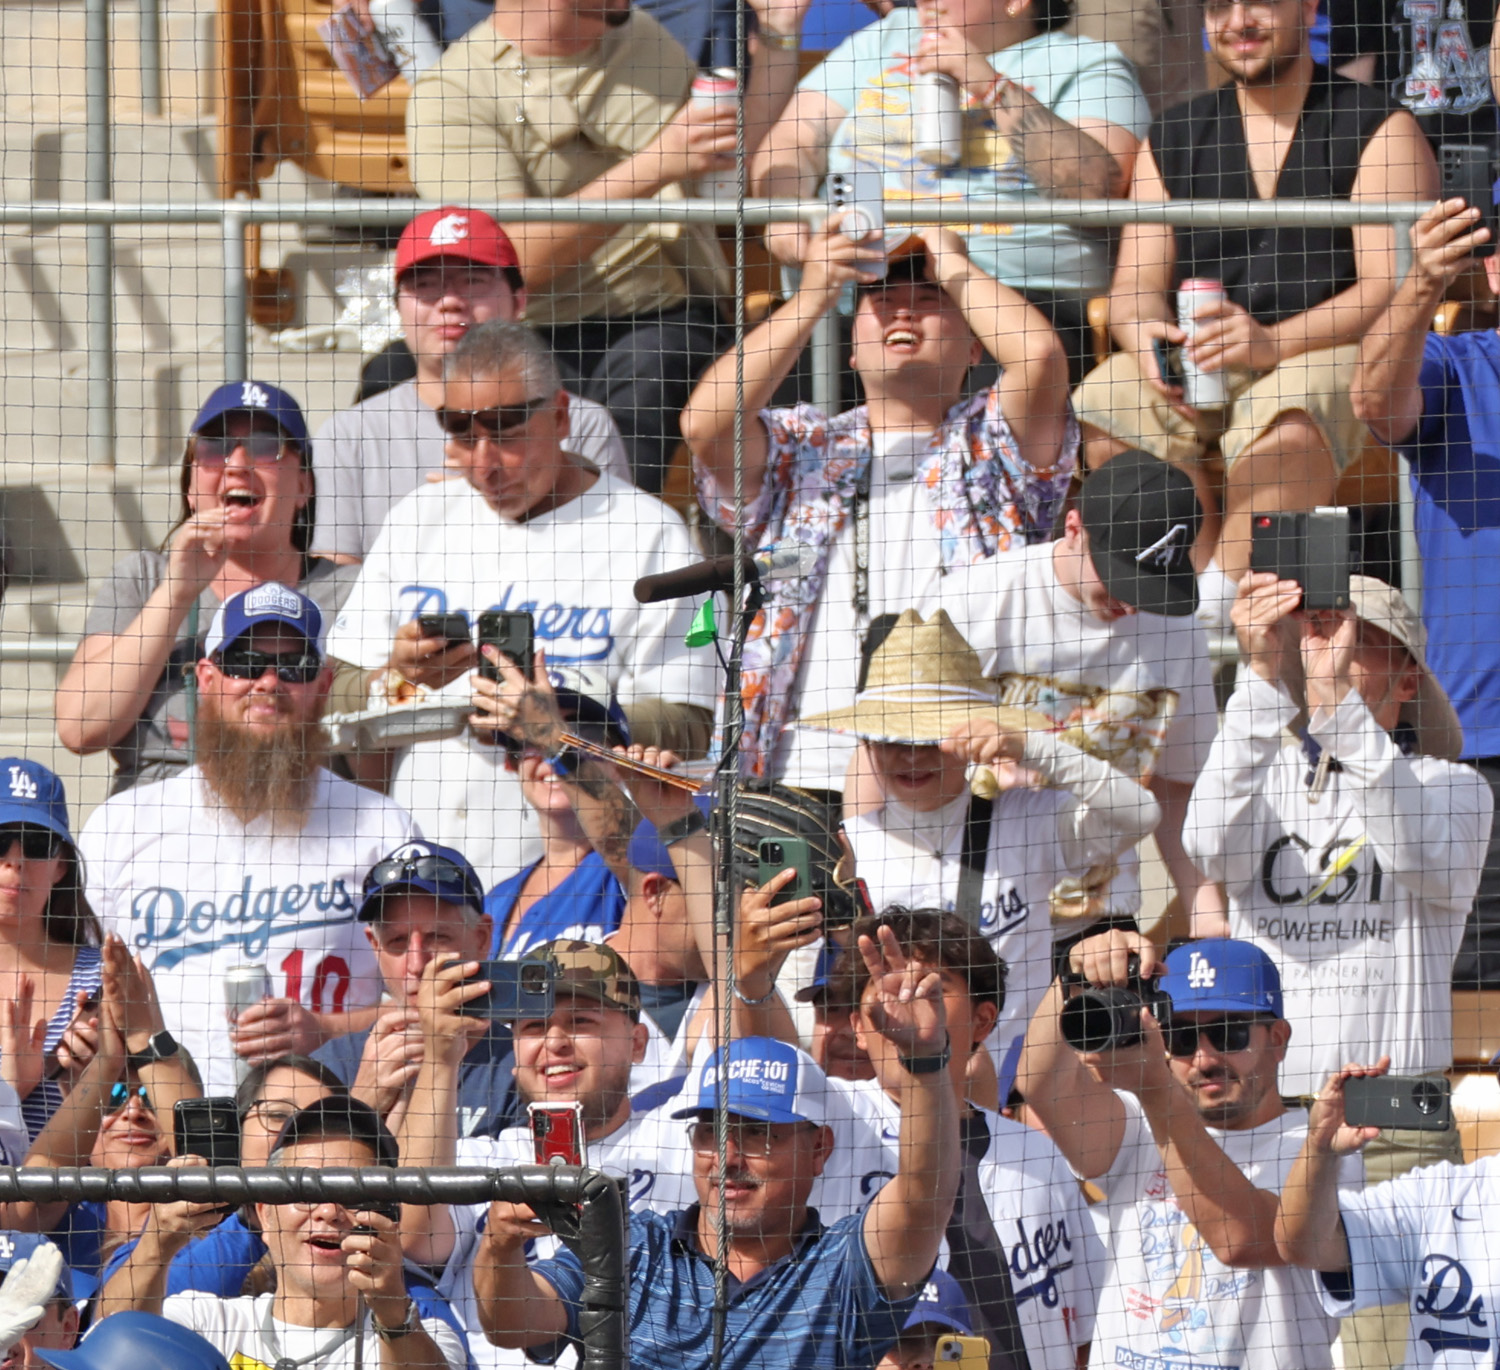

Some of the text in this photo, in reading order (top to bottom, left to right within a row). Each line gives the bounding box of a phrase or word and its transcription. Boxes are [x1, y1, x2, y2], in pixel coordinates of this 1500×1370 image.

[241, 381, 269, 407] LA
[251, 592, 298, 610] DODGERS
[8, 766, 37, 799] LA
[132, 875, 356, 958] Dodgers
[1256, 916, 1392, 943] POWERLINE
[1187, 951, 1217, 989] LA
[1293, 966, 1360, 980] PATNER
